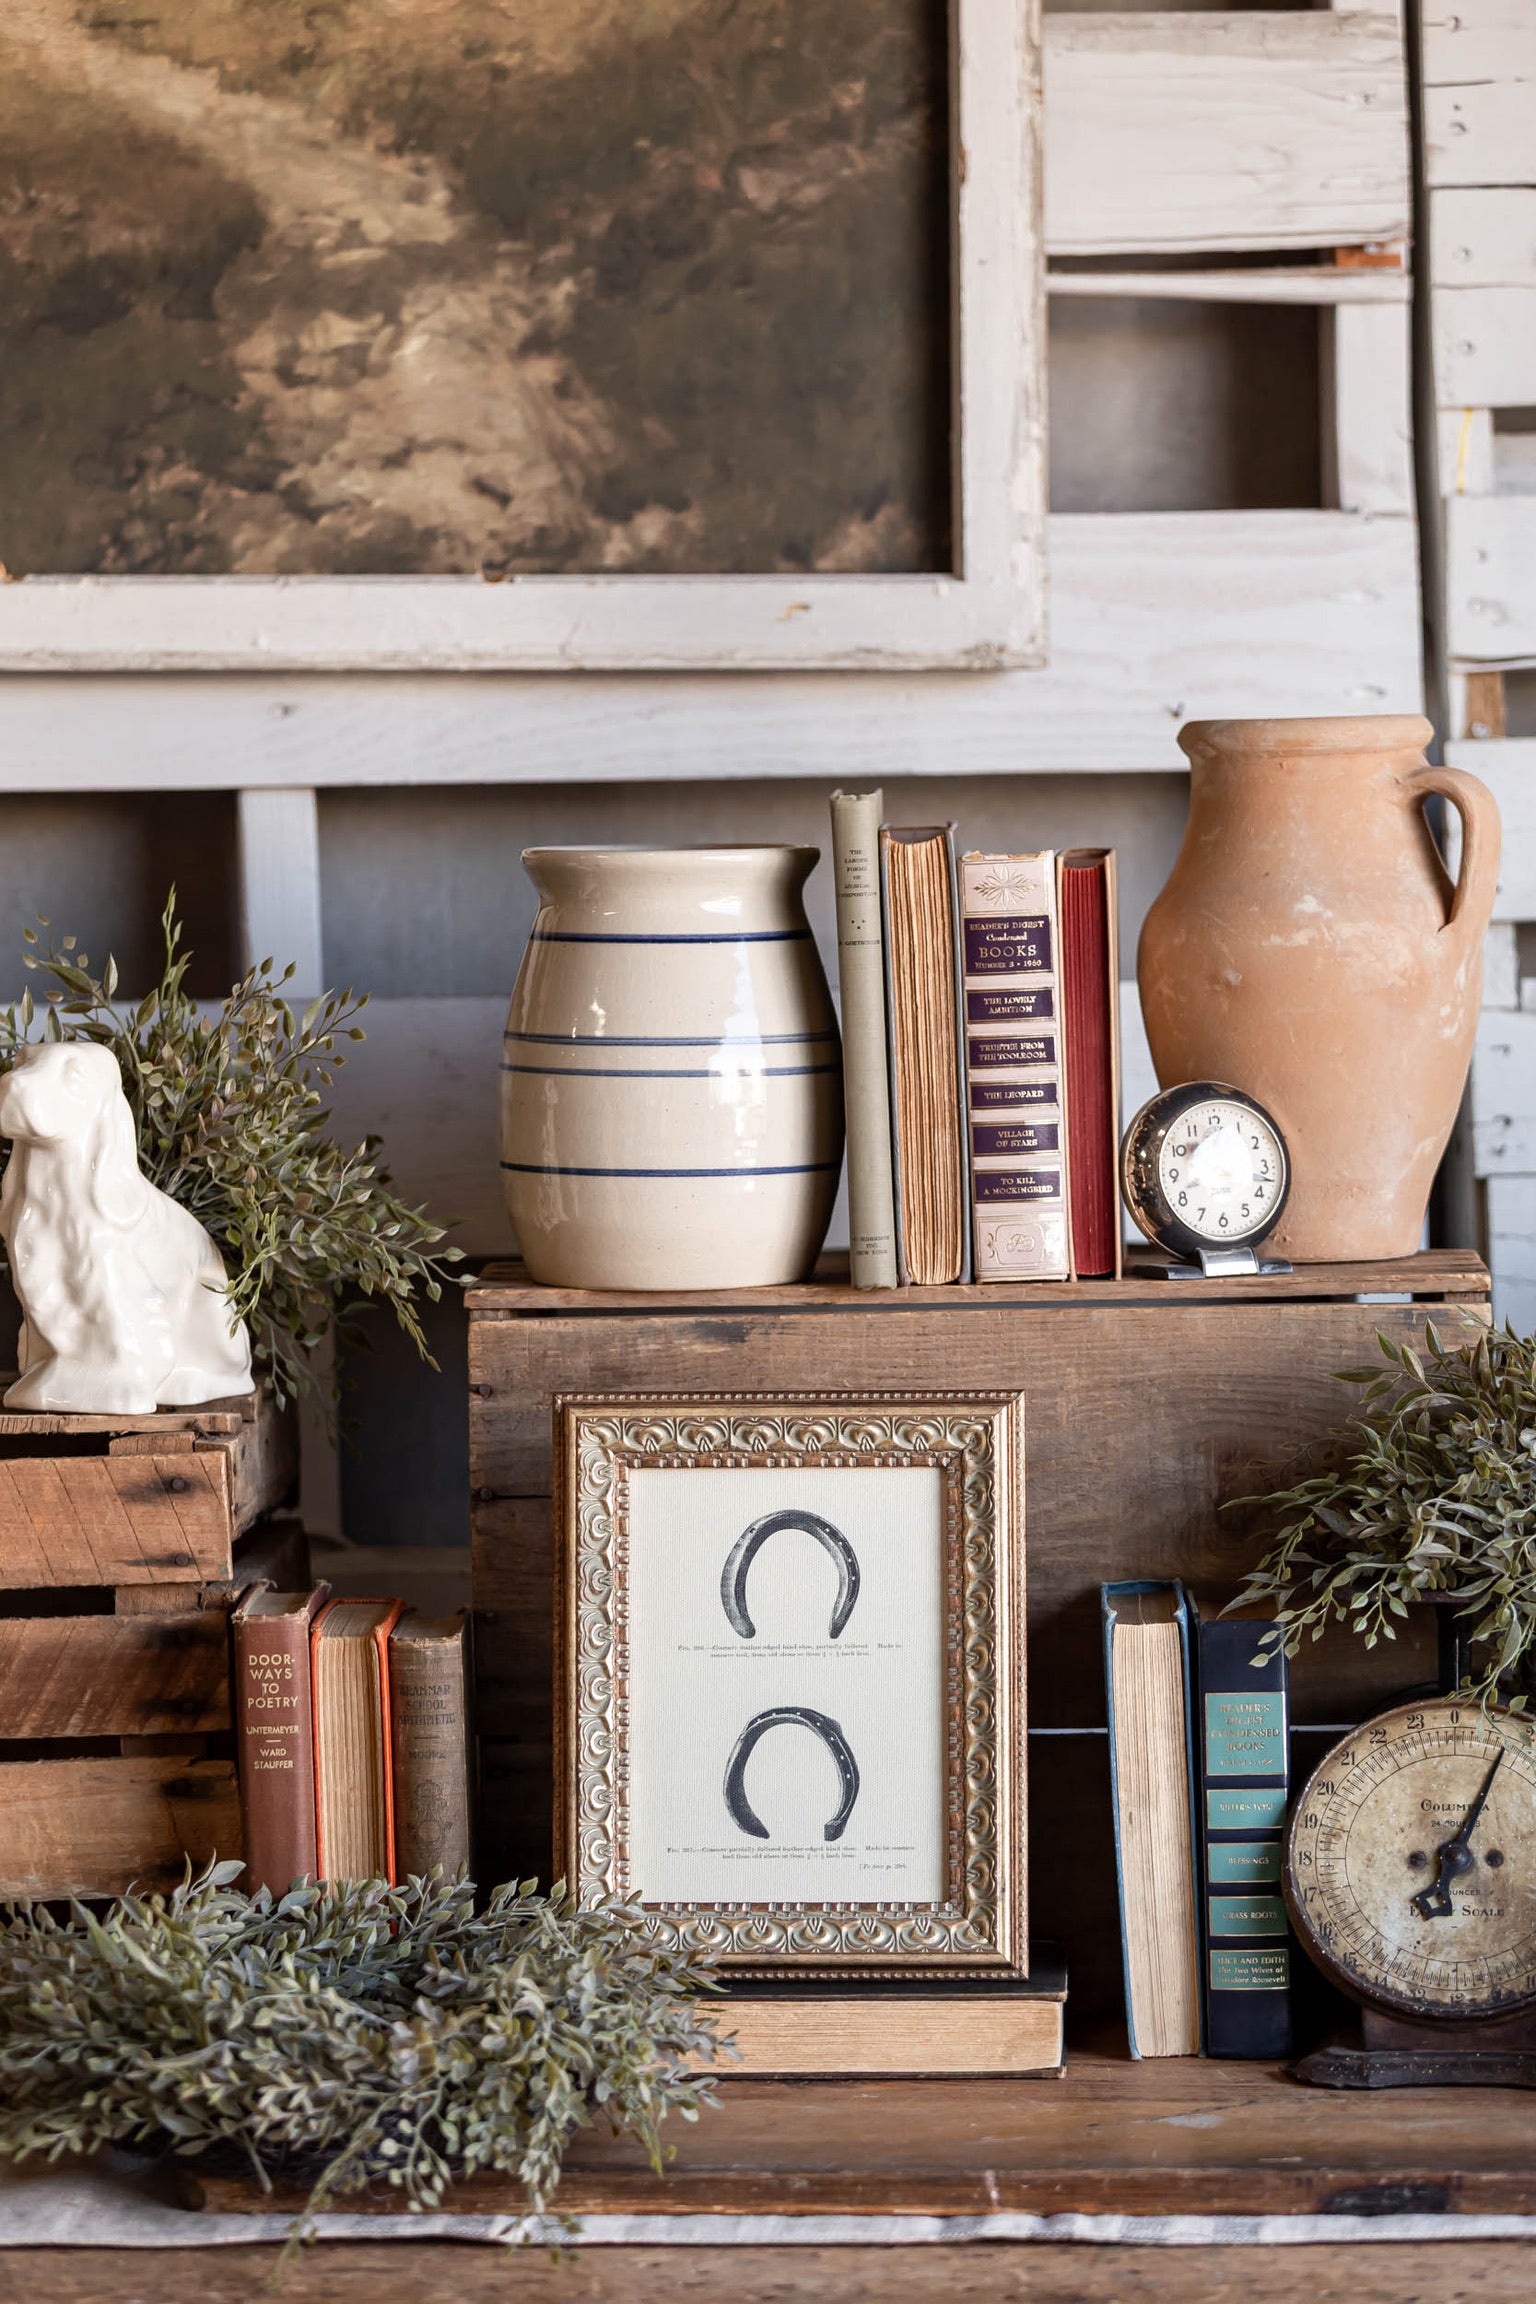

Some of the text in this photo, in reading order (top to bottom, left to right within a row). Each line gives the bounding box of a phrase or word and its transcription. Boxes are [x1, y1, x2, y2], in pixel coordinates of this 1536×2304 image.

[969, 922, 1009, 931] READER'S
[978, 944, 1037, 958] BOOKS
[1023, 959, 1042, 967] 1960
[984, 995, 1037, 1005] THE LOVELY
[988, 1005, 1033, 1014] AMBITION
[979, 1041, 1045, 1051] TRUSTEE FROM
[978, 1051, 1047, 1061] THE TOOLROOM
[984, 1089, 1044, 1100] THE LEOPARD
[1208, 1115, 1220, 1126] 12
[997, 1129, 1035, 1138] VILLAGE
[1187, 1124, 1197, 1137] 11
[1236, 1121, 1241, 1134] 1
[995, 1138, 1038, 1148] OF STARS
[1251, 1136, 1259, 1150] 2
[1172, 1144, 1187, 1157] 10
[1260, 1159, 1269, 1174] 3
[1001, 1176, 1036, 1185] TO KILL
[1169, 1168, 1179, 1184] 9
[983, 1184, 1054, 1196] A MOCKINGBIRD
[1254, 1185, 1264, 1199] 4
[1178, 1191, 1188, 1207] 8
[1197, 1207, 1206, 1222] 7
[1241, 1203, 1250, 1218] 5
[1218, 1212, 1228, 1228] 6
[249, 1653, 296, 1666] DOOR-
[250, 1667, 293, 1680] WAYS
[261, 1682, 280, 1695] TO
[247, 1695, 299, 1709] POETRY
[406, 1700, 446, 1711] SCHOOL
[1221, 1703, 1271, 1713] READER'S
[1406, 1713, 1425, 1730] 23
[1450, 1708, 1459, 1724] 0
[245, 1725, 300, 1735] UNTERMEYER
[1210, 1728, 1280, 1738] CONDENSED
[1369, 1728, 1387, 1744] 22
[259, 1748, 287, 1757] WARD
[1227, 1741, 1266, 1751] BOOKS
[254, 1759, 294, 1770] STAUFFER
[1341, 1751, 1356, 1766] 21
[1317, 1781, 1335, 1796] 20
[1420, 1799, 1490, 1812] COLUMA
[1303, 1814, 1318, 1829] 19
[1228, 1857, 1269, 1865] BLESSINGS
[1298, 1850, 1313, 1866] 18
[1303, 1887, 1318, 1902] 17
[1223, 1911, 1277, 1919] GRASS ROOTS
[1462, 1905, 1505, 1917] SCALE
[1319, 1921, 1333, 1937] 16
[1343, 1951, 1358, 1966] 15
[1251, 1966, 1273, 1974] Wives
[1252, 1975, 1286, 1984] Roosevelt
[1374, 1975, 1388, 1987] 14
